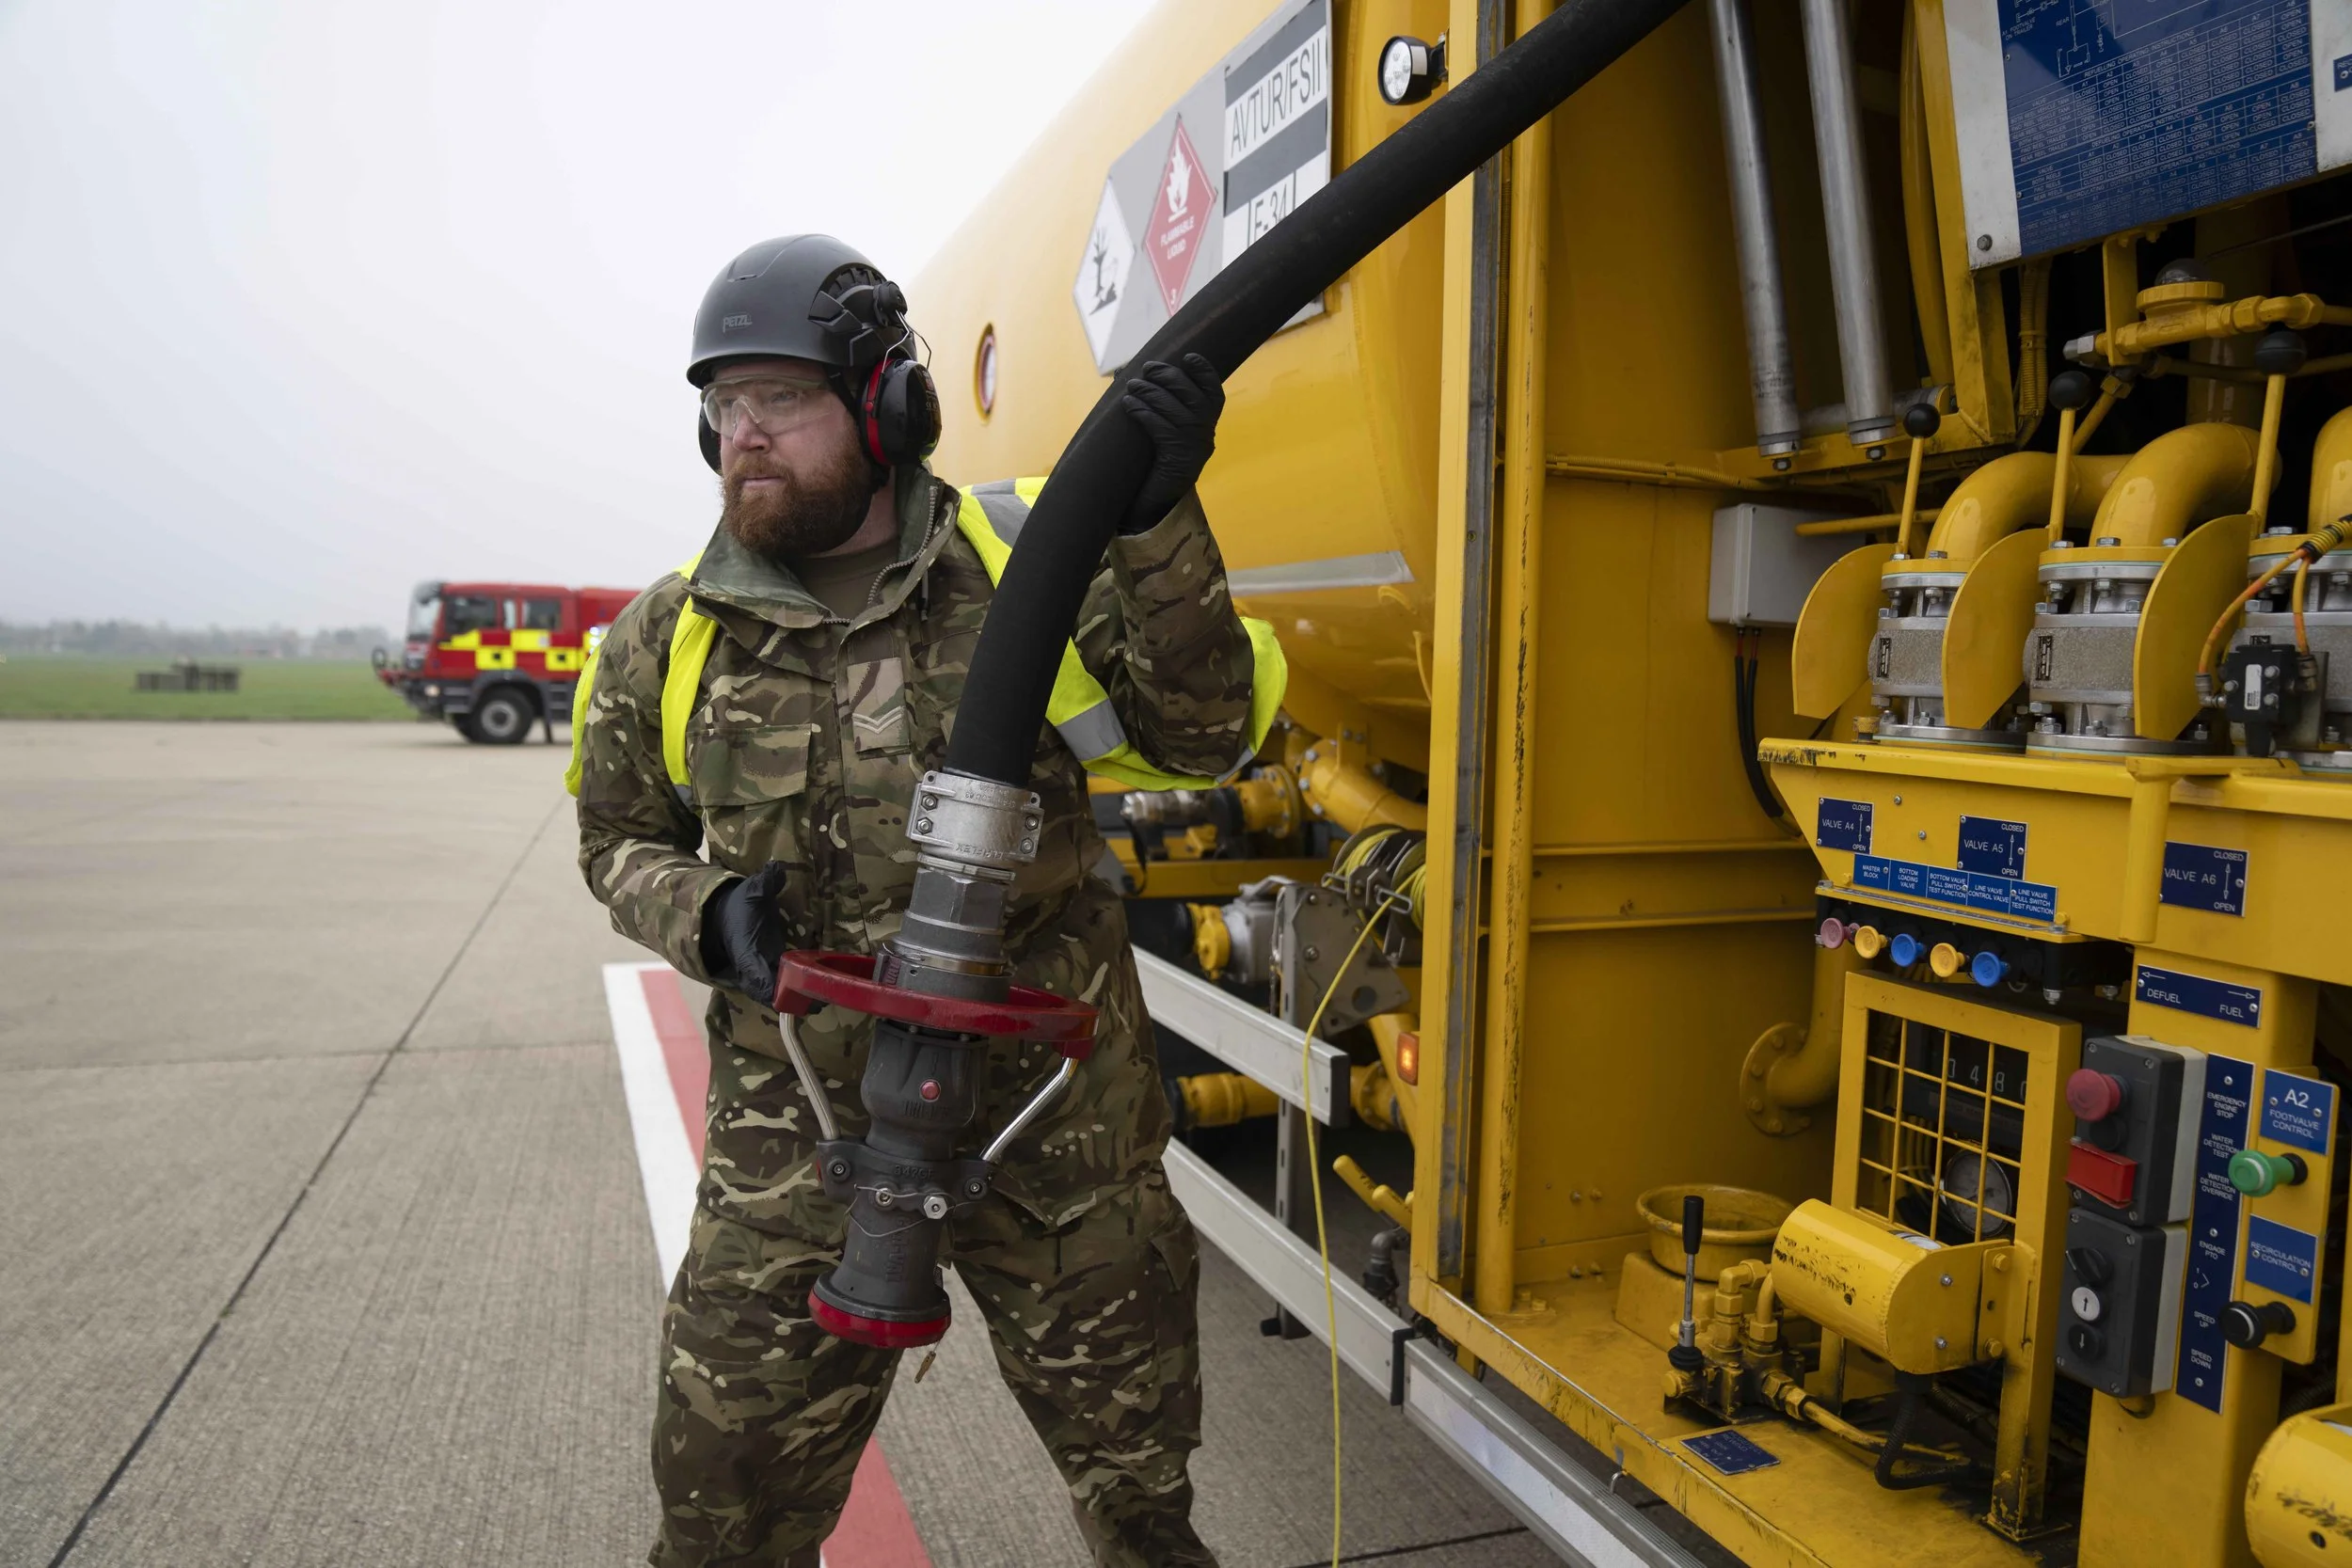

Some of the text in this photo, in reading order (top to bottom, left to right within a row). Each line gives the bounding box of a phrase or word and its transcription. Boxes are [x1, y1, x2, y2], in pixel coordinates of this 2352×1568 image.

[2010, 17, 2036, 32] FOOTVALVE
[2056, 16, 2070, 27] REAR
[2015, 24, 2034, 36] TRAILER
[2075, 86, 2095, 99] CLOSED
[2103, 78, 2118, 89] OPEN
[2125, 66, 2148, 80] CLOSED
[2156, 56, 2173, 68] OPEN
[2181, 44, 2206, 59] CLOSED
[2211, 31, 2237, 47] CLOSED
[2242, 18, 2270, 35] CLOSED
[2280, 7, 2301, 21] OPEN
[2084, 60, 2115, 78] REFUELLING
[2118, 47, 2148, 64] OPERATING
[2151, 28, 2194, 51] INSTRUCTIONS
[1232, 39, 1321, 158] AVTUR/FSII
[2082, 131, 2096, 141] OPEN
[2103, 121, 2124, 133] CLOSED
[2128, 111, 2151, 125] CLOSED
[2159, 103, 2176, 114] OPEN
[2184, 91, 2208, 105] CLOSED
[2213, 80, 2240, 95] CLOSED
[2245, 68, 2273, 84] CLOSED
[2279, 56, 2308, 72] CLOSED
[2122, 121, 2153, 137] OPERATING
[2155, 105, 2198, 125] INSTRUCTIONS
[2081, 157, 2102, 169] CLOSED
[2105, 148, 2127, 161] CLOSED
[2131, 139, 2154, 152] CLOSED
[2158, 130, 2181, 143] CLOSED
[2190, 121, 2208, 133] OPEN
[2220, 111, 2238, 123] OPEN
[2251, 100, 2271, 113] OPEN
[2280, 88, 2309, 103] CLOSED
[2082, 165, 2103, 177] CLOSED
[2106, 157, 2128, 169] CLOSED
[2132, 149, 2154, 161] CLOSED
[2159, 139, 2182, 152] CLOSED
[2187, 130, 2212, 143] CLOSED
[2220, 121, 2239, 133] OPEN
[2252, 110, 2271, 122] OPEN
[2281, 98, 2310, 113] CLOSED
[2082, 174, 2103, 185] CLOSED
[2107, 166, 2128, 178] CLOSED
[2132, 157, 2155, 170] CLOSED
[2159, 149, 2183, 161] CLOSED
[2191, 140, 2209, 151] OPEN
[2221, 130, 2239, 142] OPEN
[2249, 119, 2276, 133] CLOSED
[2281, 108, 2310, 123] CLOSED
[2135, 167, 2157, 179] SOURCE
[2159, 155, 2193, 171] OPERATING
[2195, 141, 2240, 160] INSTRUCTIONS
[2038, 164, 2053, 174] VALVE
[1167, 238, 1186, 260] LIQUID
[723, 311, 752, 332] PETZL
[1822, 819, 1842, 829] VALVE
[2001, 824, 2024, 832] CLOSED
[1964, 839, 2003, 853] VALVE A5
[2214, 851, 2244, 861] CLOSED
[1899, 868, 1918, 876] BOTTOM
[2002, 868, 2018, 876] OPEN
[2164, 867, 2216, 885] VALVE A6
[1898, 875, 1918, 883] LOADING
[1900, 881, 1915, 890] VALVE
[1930, 873, 1966, 885] BOTTOM VALVE
[1941, 888, 1966, 899] FUNCTION
[1968, 890, 2009, 903] CONTROL VALVE
[1987, 887, 2003, 895] VALVE
[2029, 898, 2050, 907] SWITCH
[2214, 902, 2235, 912] OPEN
[2026, 904, 2053, 915] FUNCTION
[2147, 988, 2181, 1004] DEFUEL
[2219, 1004, 2243, 1018] FUEL
[2207, 1092, 2246, 1108] EMERGENCY
[2285, 1089, 2309, 1108] A2
[2214, 1101, 2238, 1113] ENGINE
[2217, 1110, 2234, 1119] STOP
[2269, 1109, 2319, 1130] FOOTVALVE
[2273, 1120, 2314, 1139] CONTROL
[2212, 1132, 2233, 1145] WATER
[2213, 1148, 2229, 1159] TEST
[2208, 1172, 2229, 1184] WATER
[2200, 1177, 2236, 1194] DETECTION
[2201, 1186, 2233, 1201] OVERRIDE
[2199, 1240, 2226, 1255] ENGAGE
[2205, 1250, 2218, 1260] PTO
[2251, 1241, 2311, 1269] RECIRCULATION
[2261, 1254, 2298, 1273] CONTROL
[2194, 1311, 2215, 1324] SPEED
[2191, 1349, 2212, 1362] SPEED
[2191, 1356, 2211, 1369] DOWN
